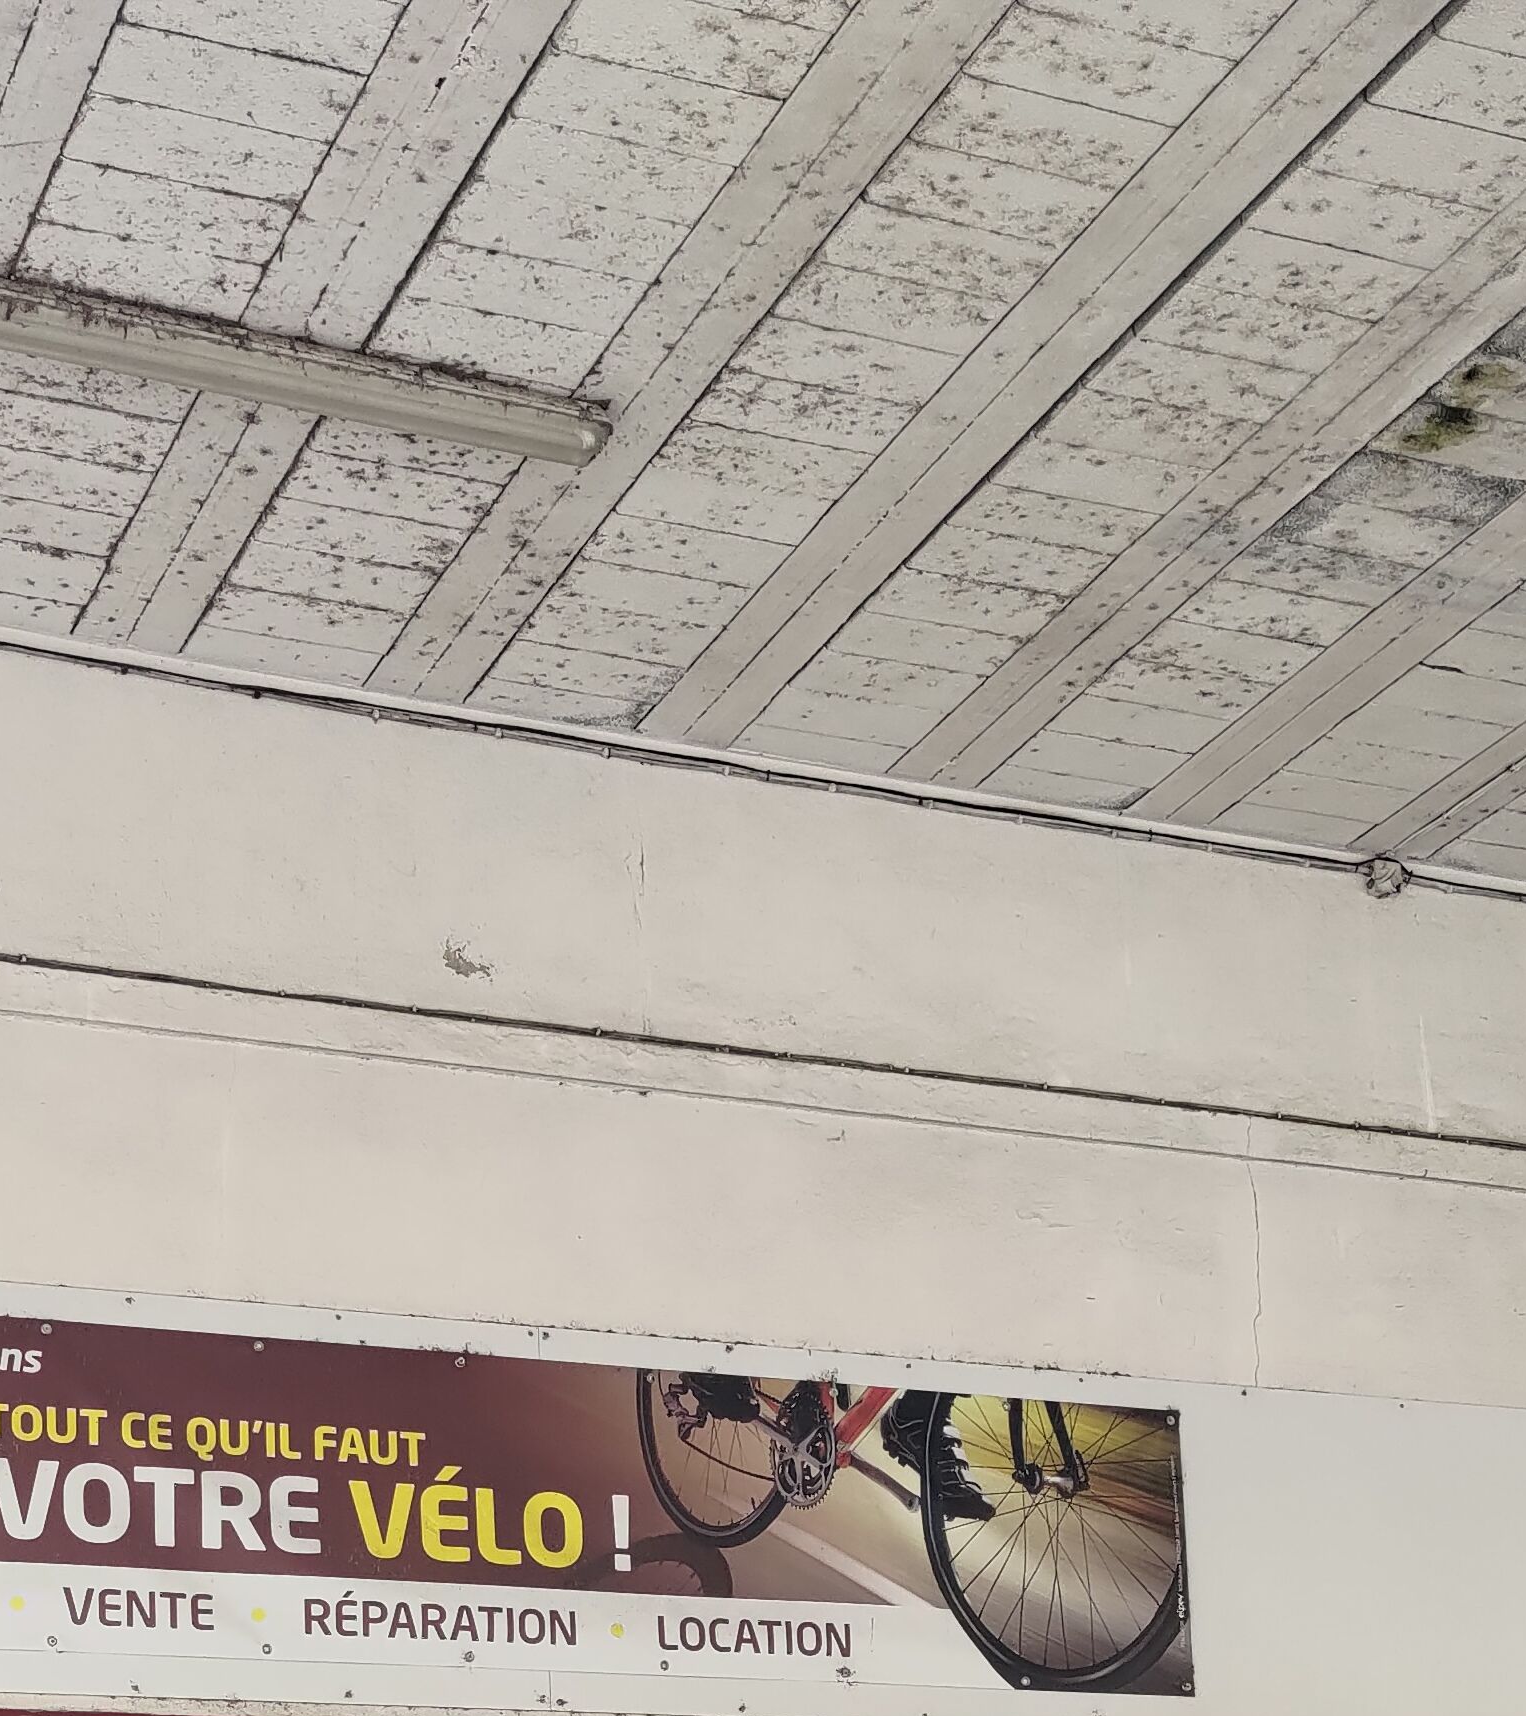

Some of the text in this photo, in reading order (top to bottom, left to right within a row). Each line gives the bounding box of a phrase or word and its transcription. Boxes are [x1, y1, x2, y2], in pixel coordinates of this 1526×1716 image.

[121, 1412, 174, 1451] CE
[314, 1426, 427, 1468] FAUT
[349, 1464, 584, 1571] VÉLO
[611, 1493, 633, 1572] !
[63, 1586, 215, 1631] VENTE
[304, 1590, 579, 1647] RÉPARATION
[658, 1615, 853, 1659] LOCATION
